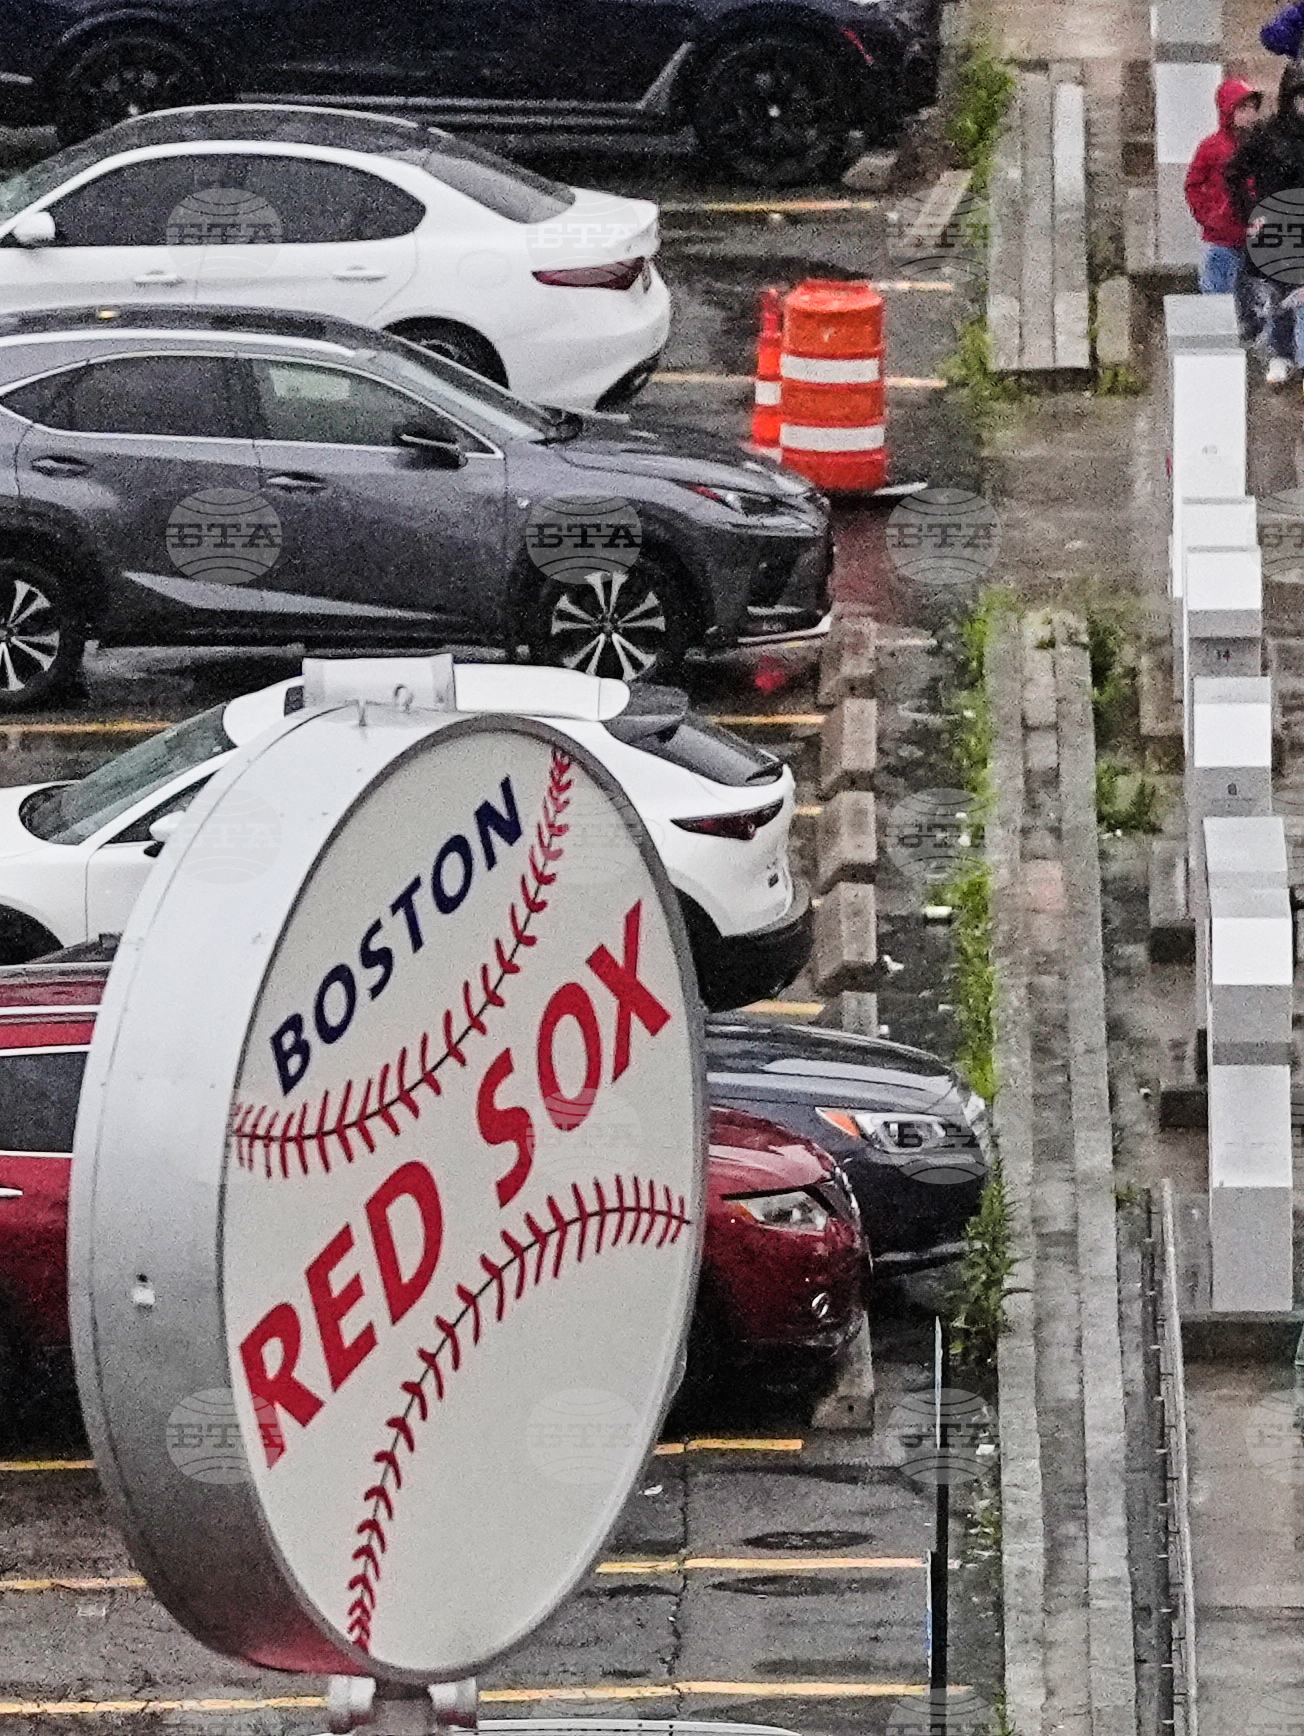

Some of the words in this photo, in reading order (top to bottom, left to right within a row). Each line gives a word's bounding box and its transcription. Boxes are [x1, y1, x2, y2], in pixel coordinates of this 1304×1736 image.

[268, 776, 525, 1097] BOSTON
[238, 1160, 443, 1471] RED
[476, 898, 671, 1208] SOX
